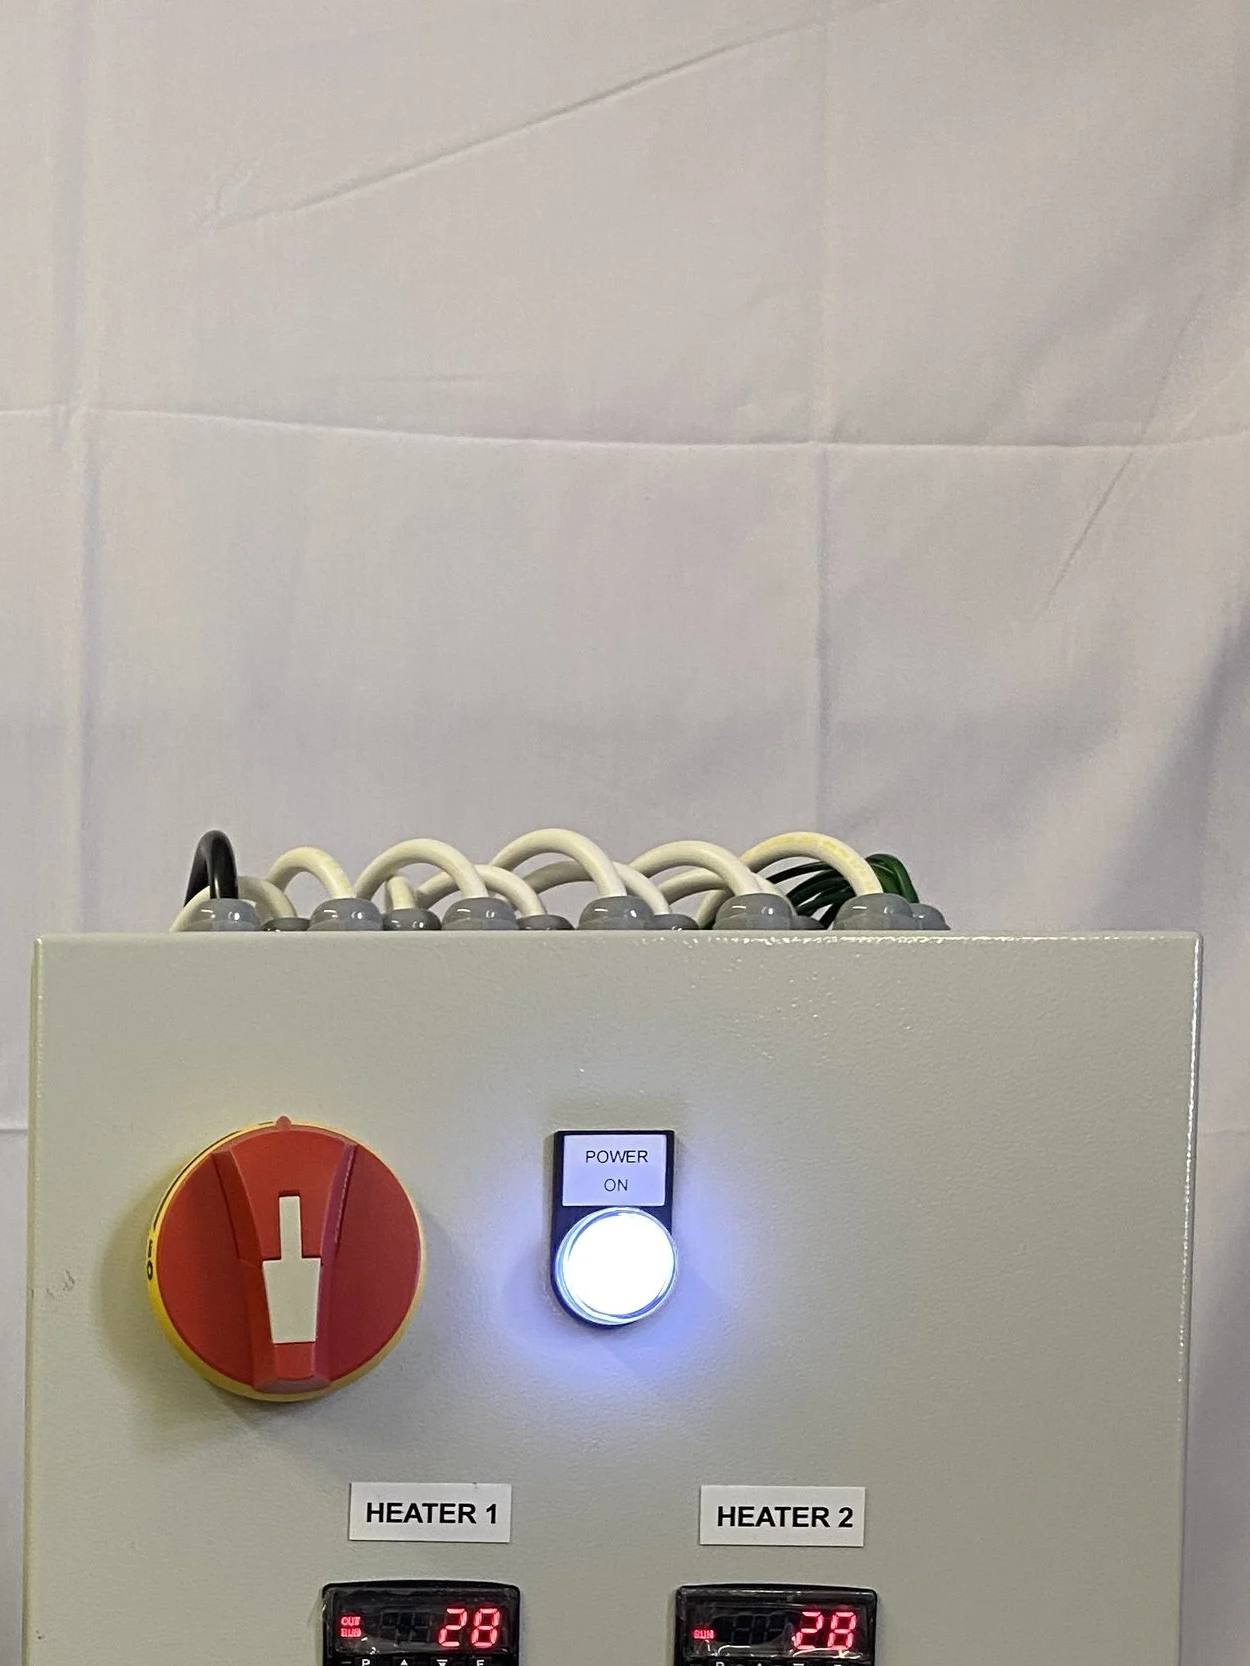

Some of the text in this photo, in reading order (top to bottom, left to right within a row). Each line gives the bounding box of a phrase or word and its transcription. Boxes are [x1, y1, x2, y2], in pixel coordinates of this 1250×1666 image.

[586, 1150, 648, 1163] POWER
[604, 1179, 627, 1191] ON
[367, 1503, 496, 1524] HEATER 1
[718, 1506, 853, 1527] HEATER 2
[439, 1608, 500, 1648] 28
[794, 1612, 856, 1650] 28
